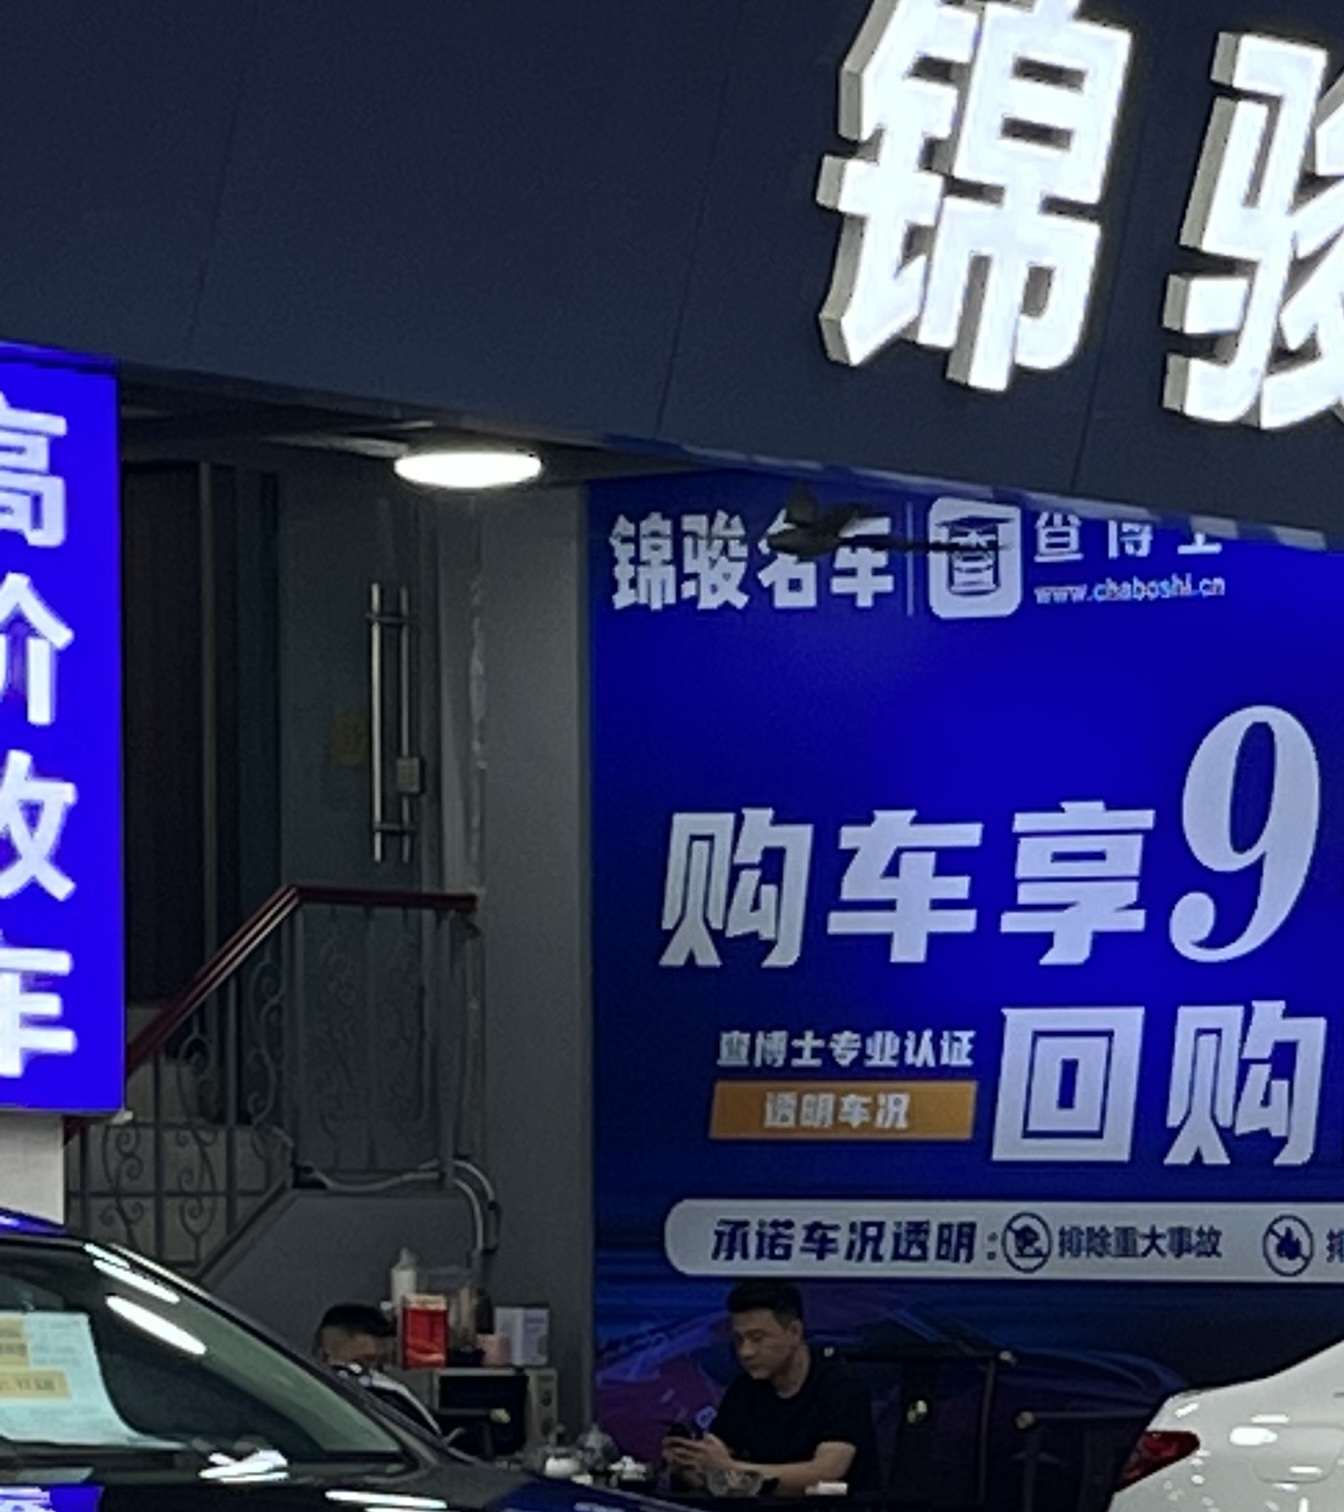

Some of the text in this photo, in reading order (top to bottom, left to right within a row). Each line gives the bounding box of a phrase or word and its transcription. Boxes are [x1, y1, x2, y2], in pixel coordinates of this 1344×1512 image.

[1033, 572, 1226, 605] www.chaboshi.cn
[716, 1029, 977, 1068] 查博士专业认证
[764, 1091, 911, 1129] 透明车况
[1057, 1224, 1224, 1260] 排除重大事故
